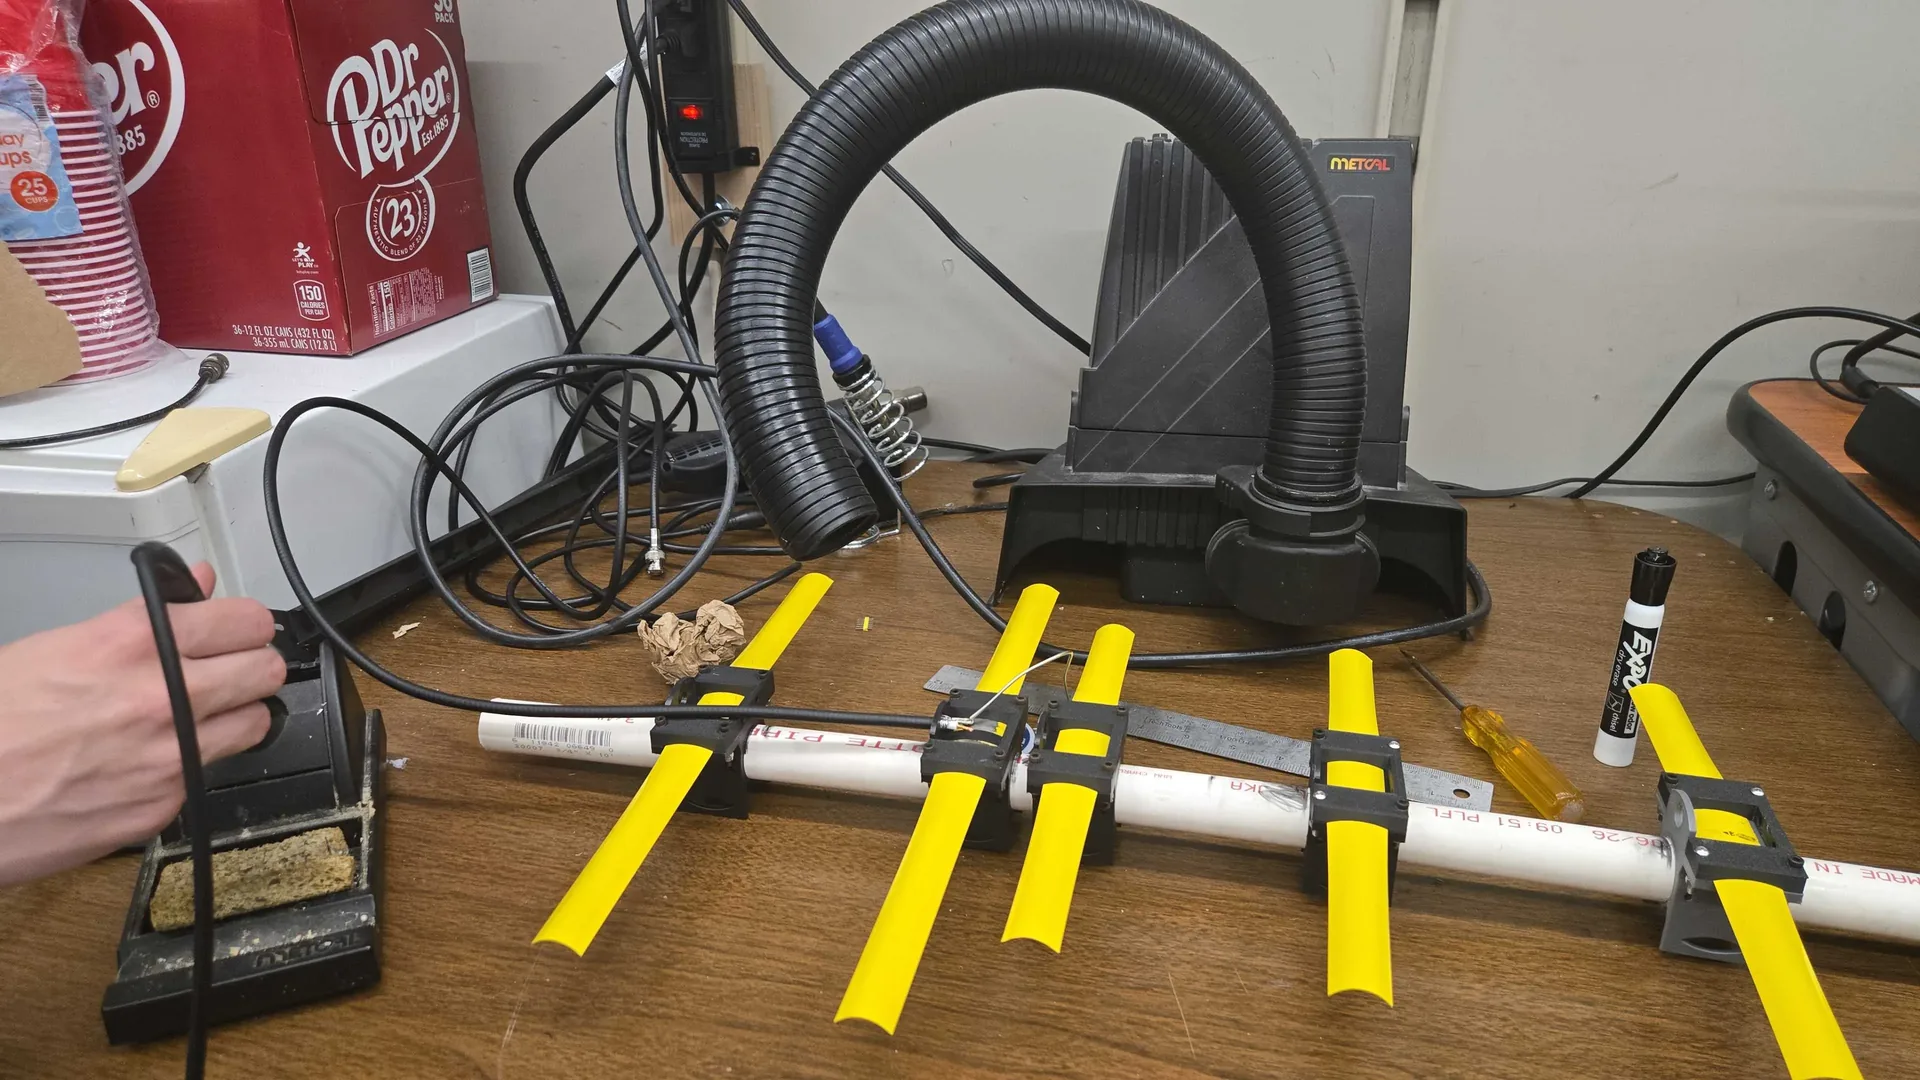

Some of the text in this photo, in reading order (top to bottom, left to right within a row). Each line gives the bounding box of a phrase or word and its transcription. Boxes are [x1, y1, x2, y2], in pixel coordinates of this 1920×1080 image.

[434, 12, 455, 23] PACK
[370, 38, 419, 108] Dr
[327, 55, 449, 179] Pepper
[0, 133, 24, 147] ay
[1330, 157, 1391, 170] METCAL
[18, 177, 48, 197] 25
[25, 196, 48, 204] CUPS
[372, 206, 389, 252] AUTHENTIC
[390, 247, 409, 256] BLEND
[409, 242, 416, 251] OF
[420, 198, 428, 235] FLAVORS
[386, 198, 415, 239] 23
[298, 285, 322, 301] 150
[382, 281, 391, 299] 150
[300, 301, 326, 309] CALORIES
[232, 324, 335, 340] 36-12 FL OZ CANS (432 FL OZ)
[252, 336, 278, 348] 36-355
[278, 338, 290, 348] mL
[291, 338, 308, 350] CANS
[309, 339, 328, 350] (12.8
[1612, 649, 1626, 687] dry erase
[1609, 712, 1620, 732] chisel
[1625, 713, 1636, 731] odor
[1426, 806, 1480, 823] PLFL
[1498, 816, 1564, 834] 09:51
[1815, 861, 1920, 885] MADE IN
